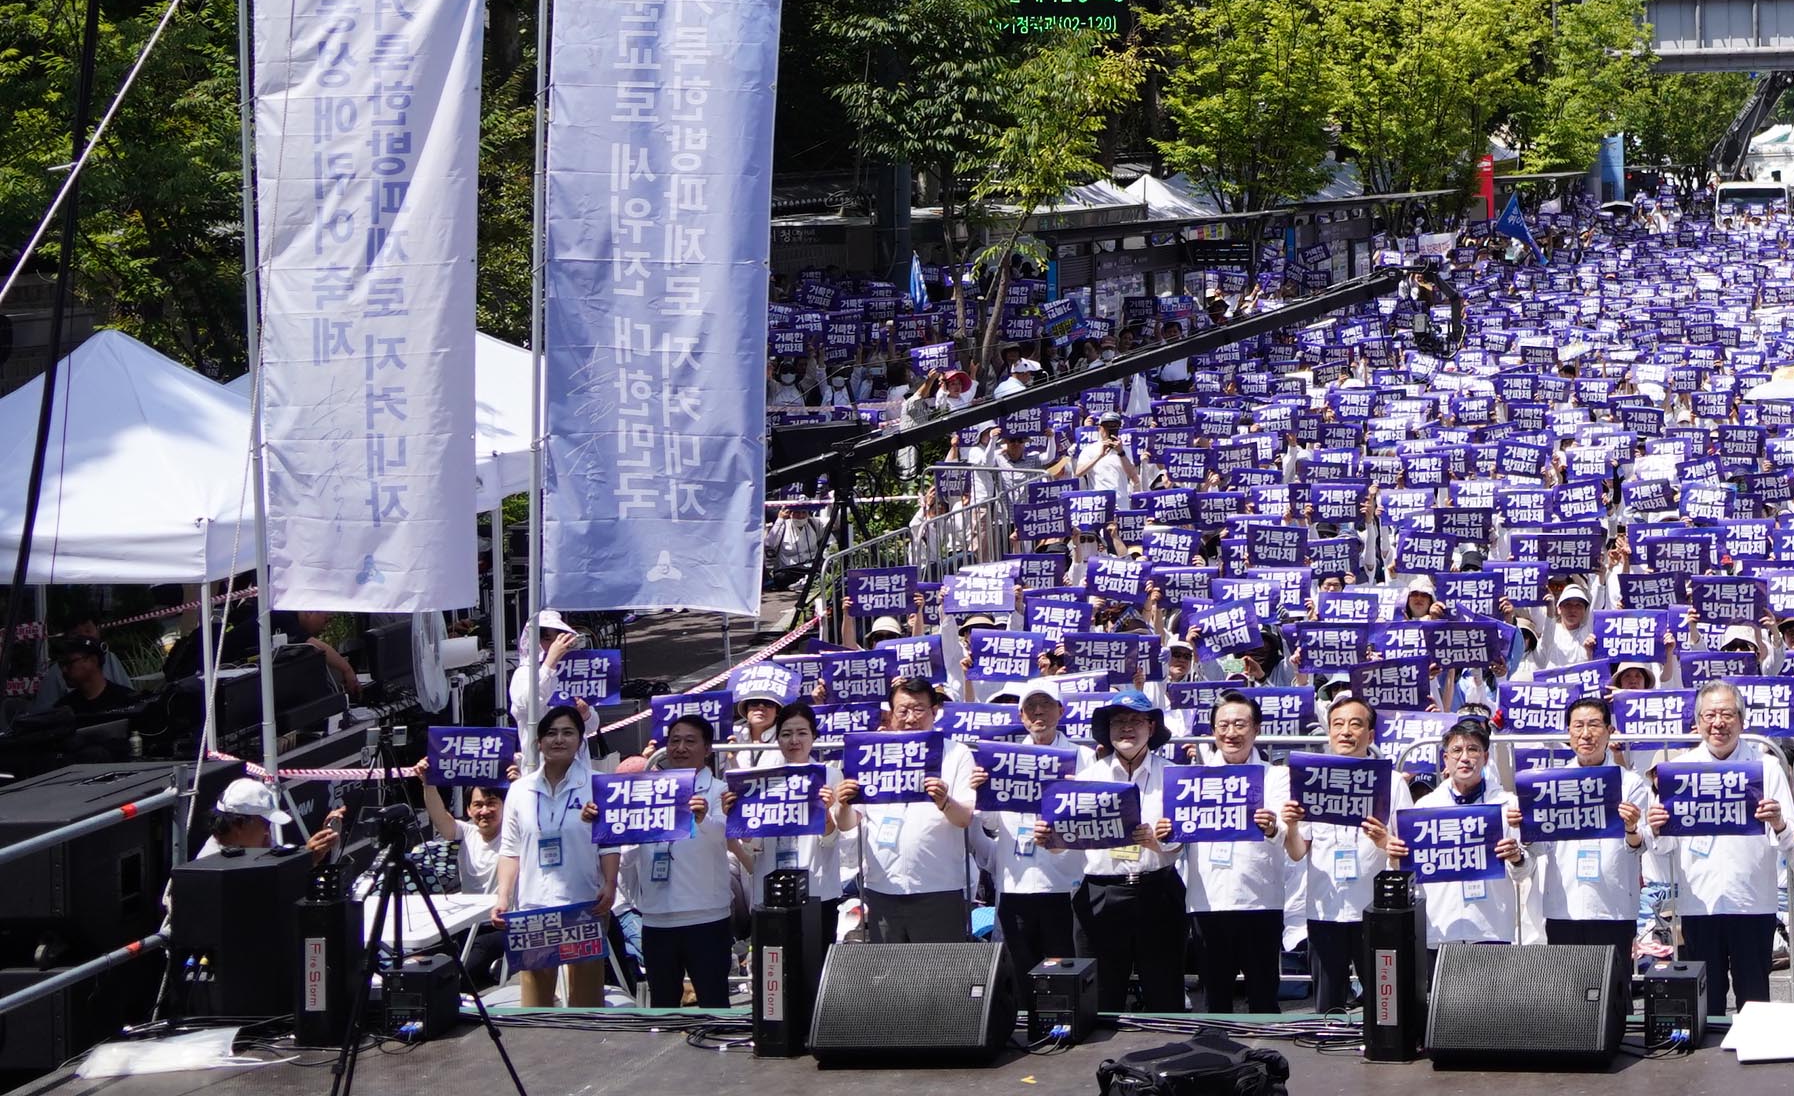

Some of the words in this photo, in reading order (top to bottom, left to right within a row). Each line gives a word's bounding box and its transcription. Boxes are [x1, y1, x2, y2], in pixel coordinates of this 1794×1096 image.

[774, 332, 804, 342] 거룩한
[774, 342, 804, 353] 방파제
[918, 345, 950, 359] 거룩한
[919, 358, 950, 371] 방파제
[1725, 429, 1757, 442] 거룩한
[1725, 442, 1758, 455] 방파제
[1409, 457, 1442, 470] 거룩한
[1409, 470, 1441, 483] 방파제
[1069, 495, 1109, 510] 거룩한
[1319, 489, 1360, 505] 거룩한
[1070, 509, 1109, 525] 방파제
[1319, 503, 1360, 518] 방파제
[1404, 538, 1448, 555] 거룩한
[1403, 554, 1446, 569] 방파제
[858, 575, 907, 592] 거룩한
[858, 592, 906, 610] 방파제
[1604, 616, 1655, 636] 거룩한
[981, 637, 1033, 658] 거룩한
[1602, 637, 1654, 656] 방파제
[556, 657, 607, 678] 거룩한
[978, 655, 1032, 676] 방파제
[440, 736, 502, 761] 거룩한
[858, 742, 928, 767] 거룩한
[438, 758, 498, 779] 방파제
[992, 750, 1060, 780] 거룩한
[606, 777, 677, 805] 거룩한
[743, 774, 812, 801] 거룩한
[858, 769, 925, 797] 방파제
[991, 777, 1040, 803] 방파
[1177, 775, 1250, 803] 거룩한
[1303, 767, 1377, 795] 거룩한
[1532, 778, 1606, 805] 거룩한
[1674, 771, 1748, 798] 거룩한
[741, 799, 809, 828] 방파제
[1054, 792, 1121, 818] 거룩한
[1302, 790, 1373, 818] 방파제
[1674, 800, 1747, 828] 방파제
[605, 805, 675, 834] 방파제
[1054, 815, 1125, 840] 방파제
[1175, 803, 1247, 833] 방파제
[1413, 816, 1487, 843] 거룩한
[1532, 805, 1606, 833] 방파제
[1413, 844, 1487, 874] 방파제
[509, 911, 562, 933] 포괄적
[508, 922, 601, 951] 차별금지법
[309, 943, 321, 969] Fire
[766, 952, 778, 978] Fire
[1381, 954, 1392, 981] Fire
[309, 971, 321, 1007] Storm
[766, 979, 778, 1017] Storm
[1380, 983, 1392, 1022] Storm
